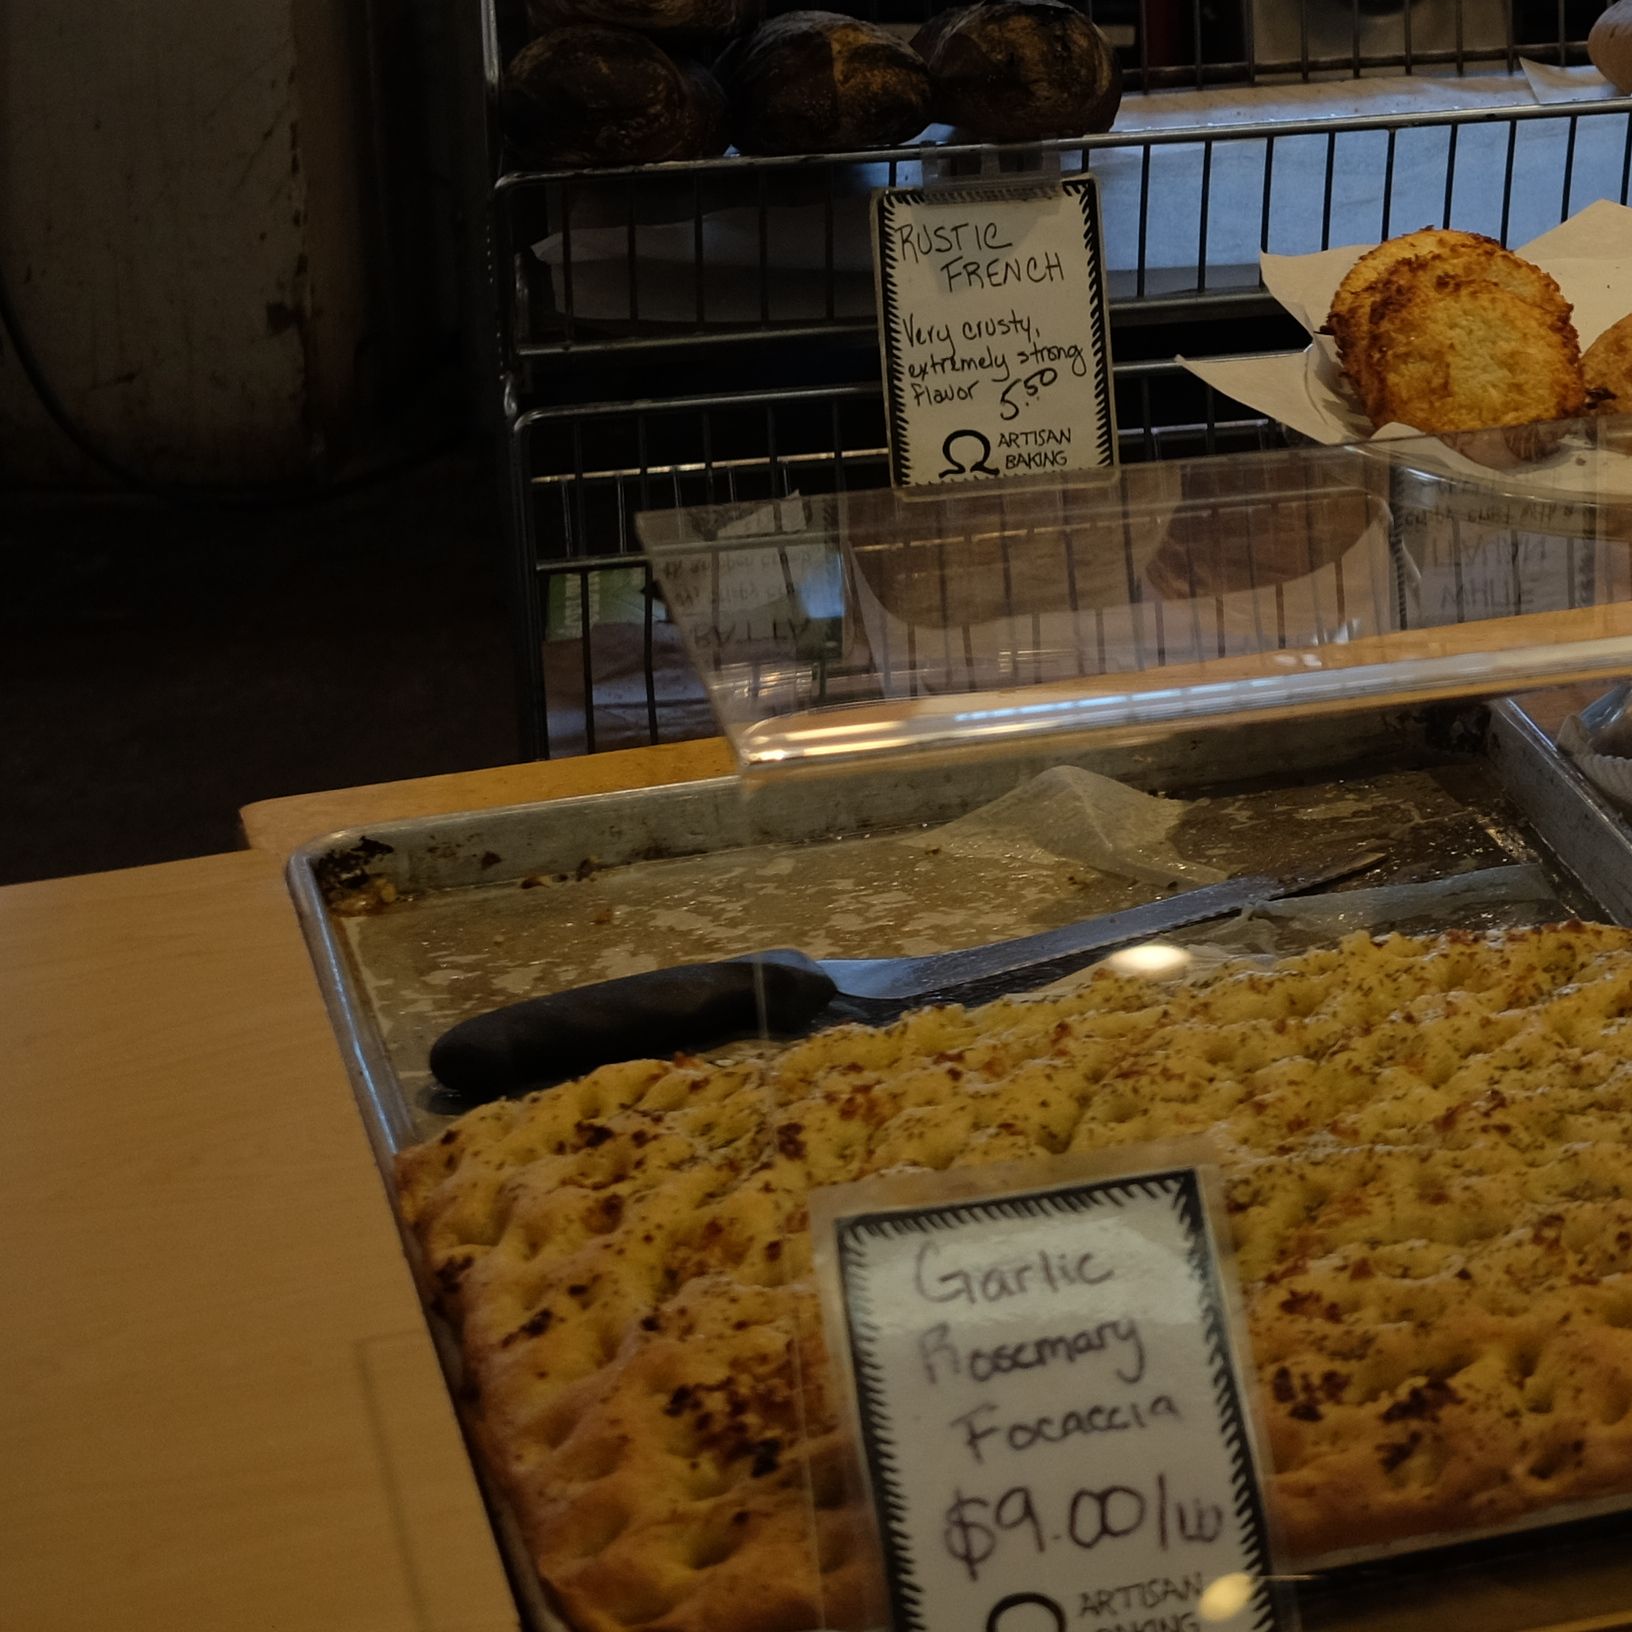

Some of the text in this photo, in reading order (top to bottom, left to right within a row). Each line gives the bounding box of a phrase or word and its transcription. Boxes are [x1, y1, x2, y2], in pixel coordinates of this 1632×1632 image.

[897, 222, 1012, 263] RUSTIC
[941, 252, 1064, 293] FRENCH
[904, 310, 1040, 356] Very crusty,
[908, 342, 1086, 382] extremely strong
[998, 429, 1071, 448] ARTISAN
[1005, 450, 1067, 469] BAKING
[914, 1238, 1116, 1305] Garlic
[917, 1319, 1145, 1385] Rosemary
[950, 1394, 1183, 1465] Focaccia
[1078, 1571, 1205, 1619] ARTISAN
